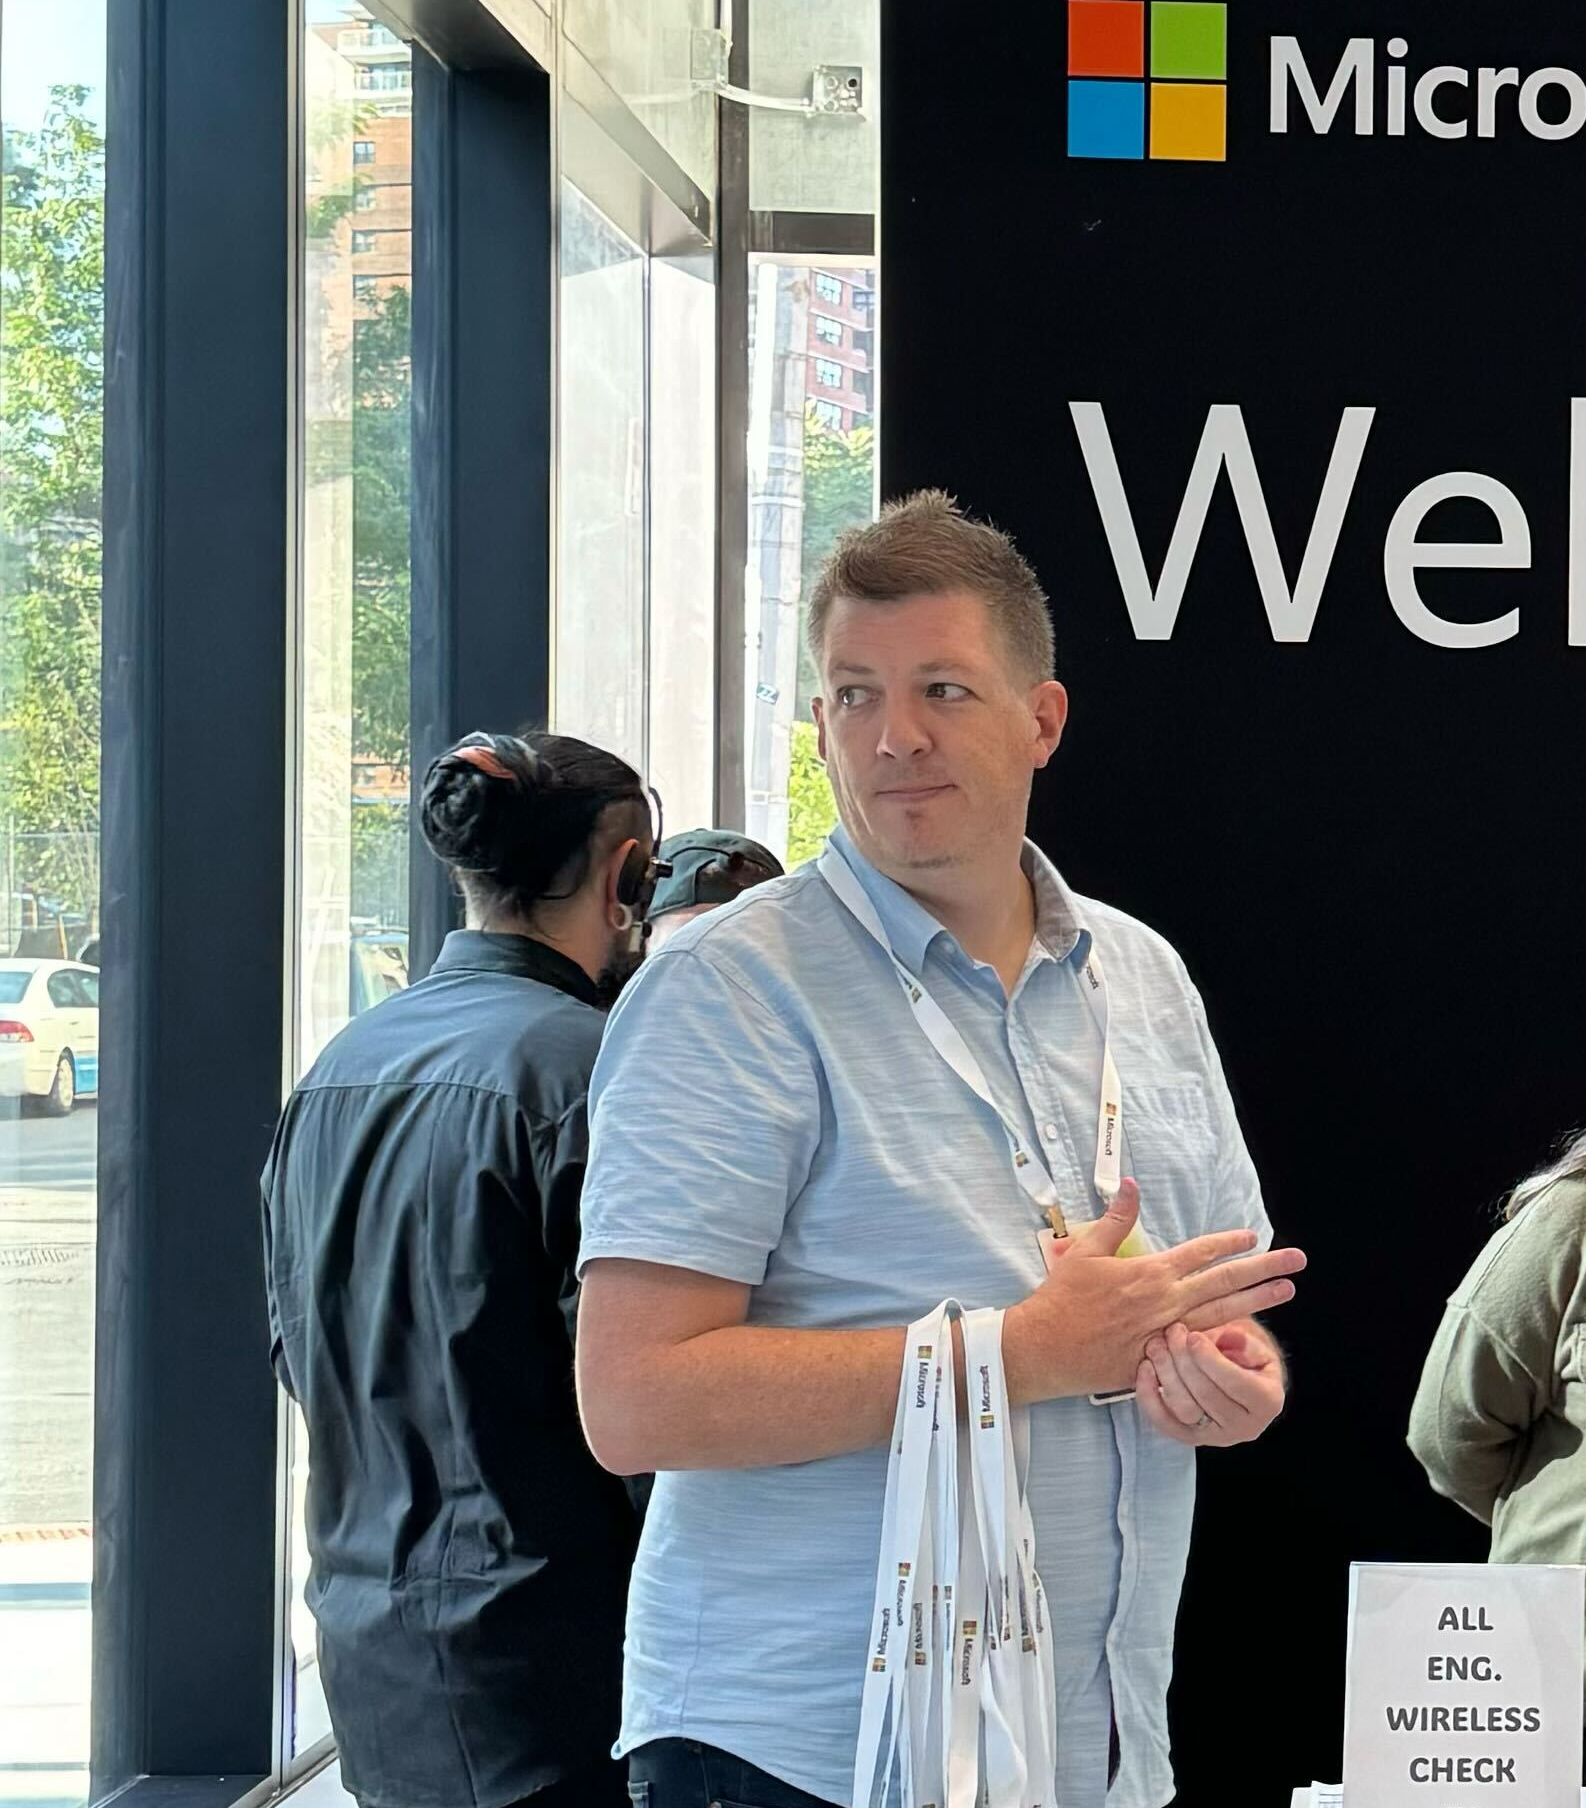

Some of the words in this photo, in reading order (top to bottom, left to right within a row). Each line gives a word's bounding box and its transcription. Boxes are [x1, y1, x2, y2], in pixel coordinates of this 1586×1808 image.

[979, 1364, 991, 1413] Microsoft
[1437, 1606, 1494, 1631] ALL
[1427, 1656, 1502, 1681] ENG.
[1386, 1706, 1541, 1732] WIRELESS
[1409, 1757, 1517, 1783] CHECK
